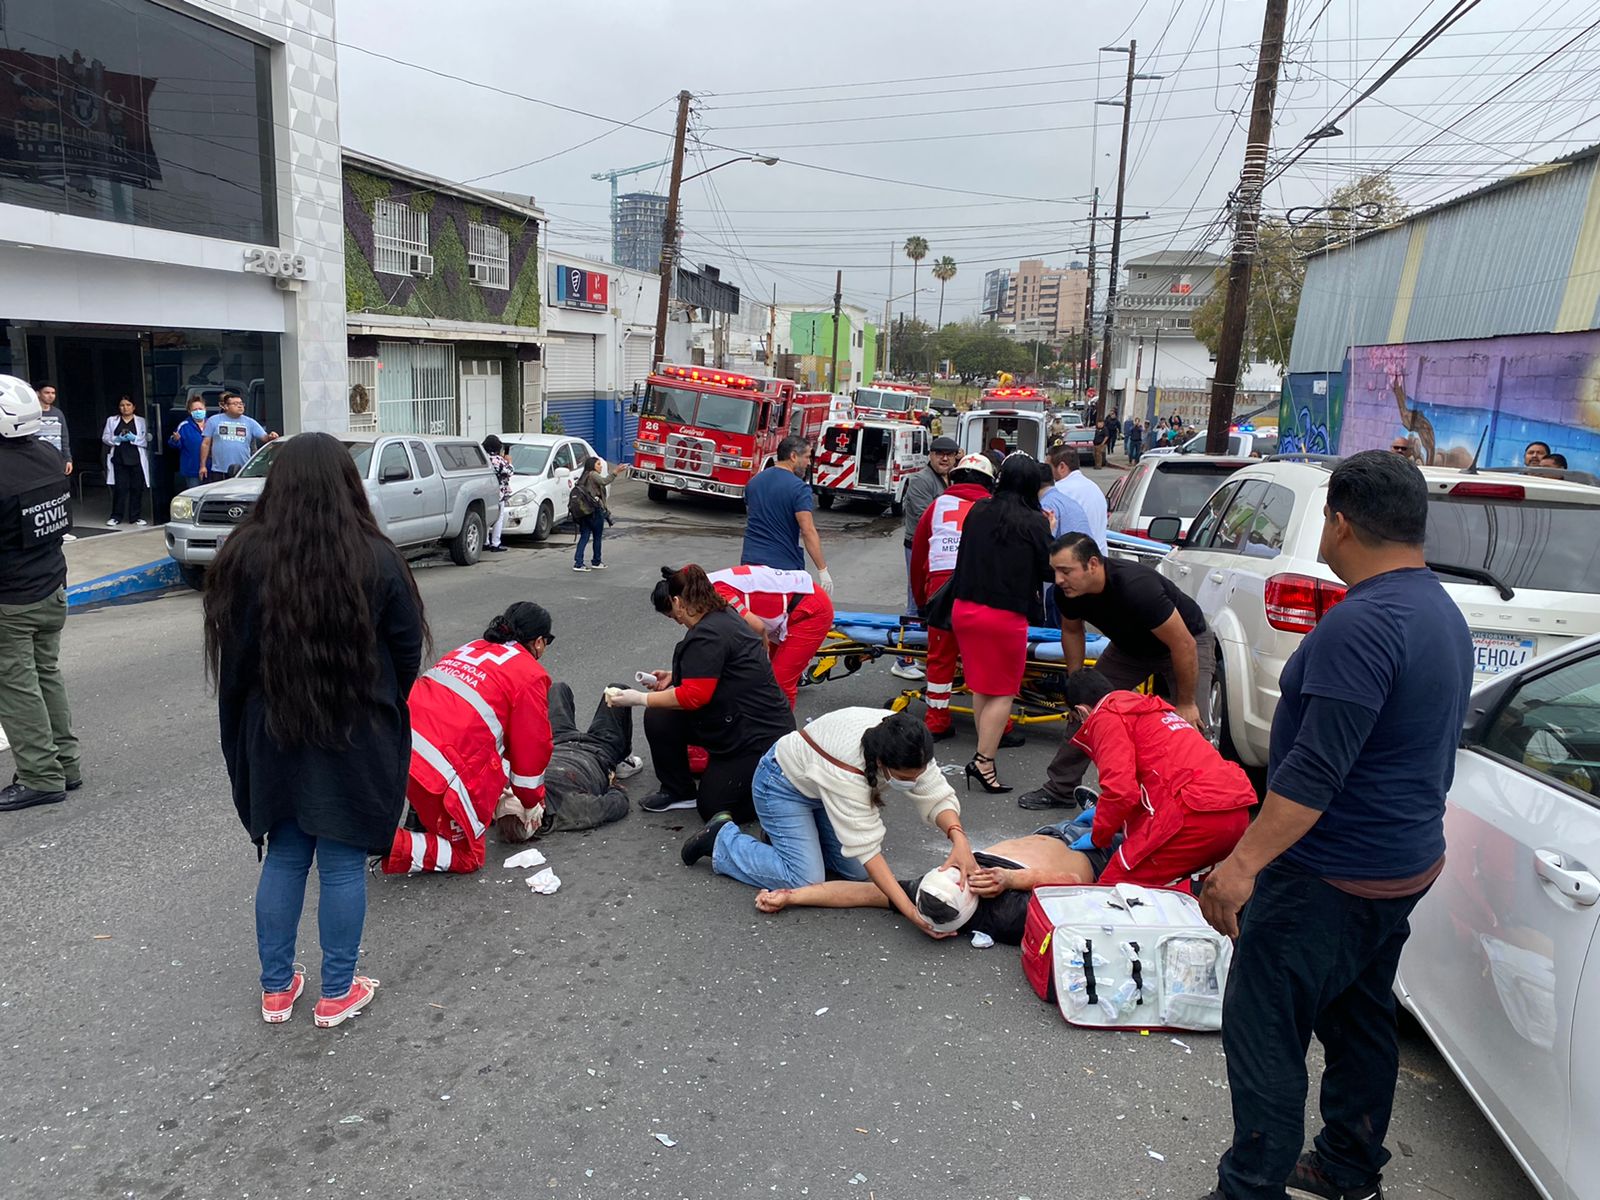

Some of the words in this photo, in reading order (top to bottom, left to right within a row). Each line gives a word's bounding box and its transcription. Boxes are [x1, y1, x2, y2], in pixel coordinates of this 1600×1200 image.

[645, 421, 659, 430] 26
[679, 426, 705, 437] Central
[674, 440, 702, 472] 26
[34, 504, 67, 527] CIVIL
[34, 517, 69, 538] TIJUANA
[461, 663, 488, 681] ROJA
